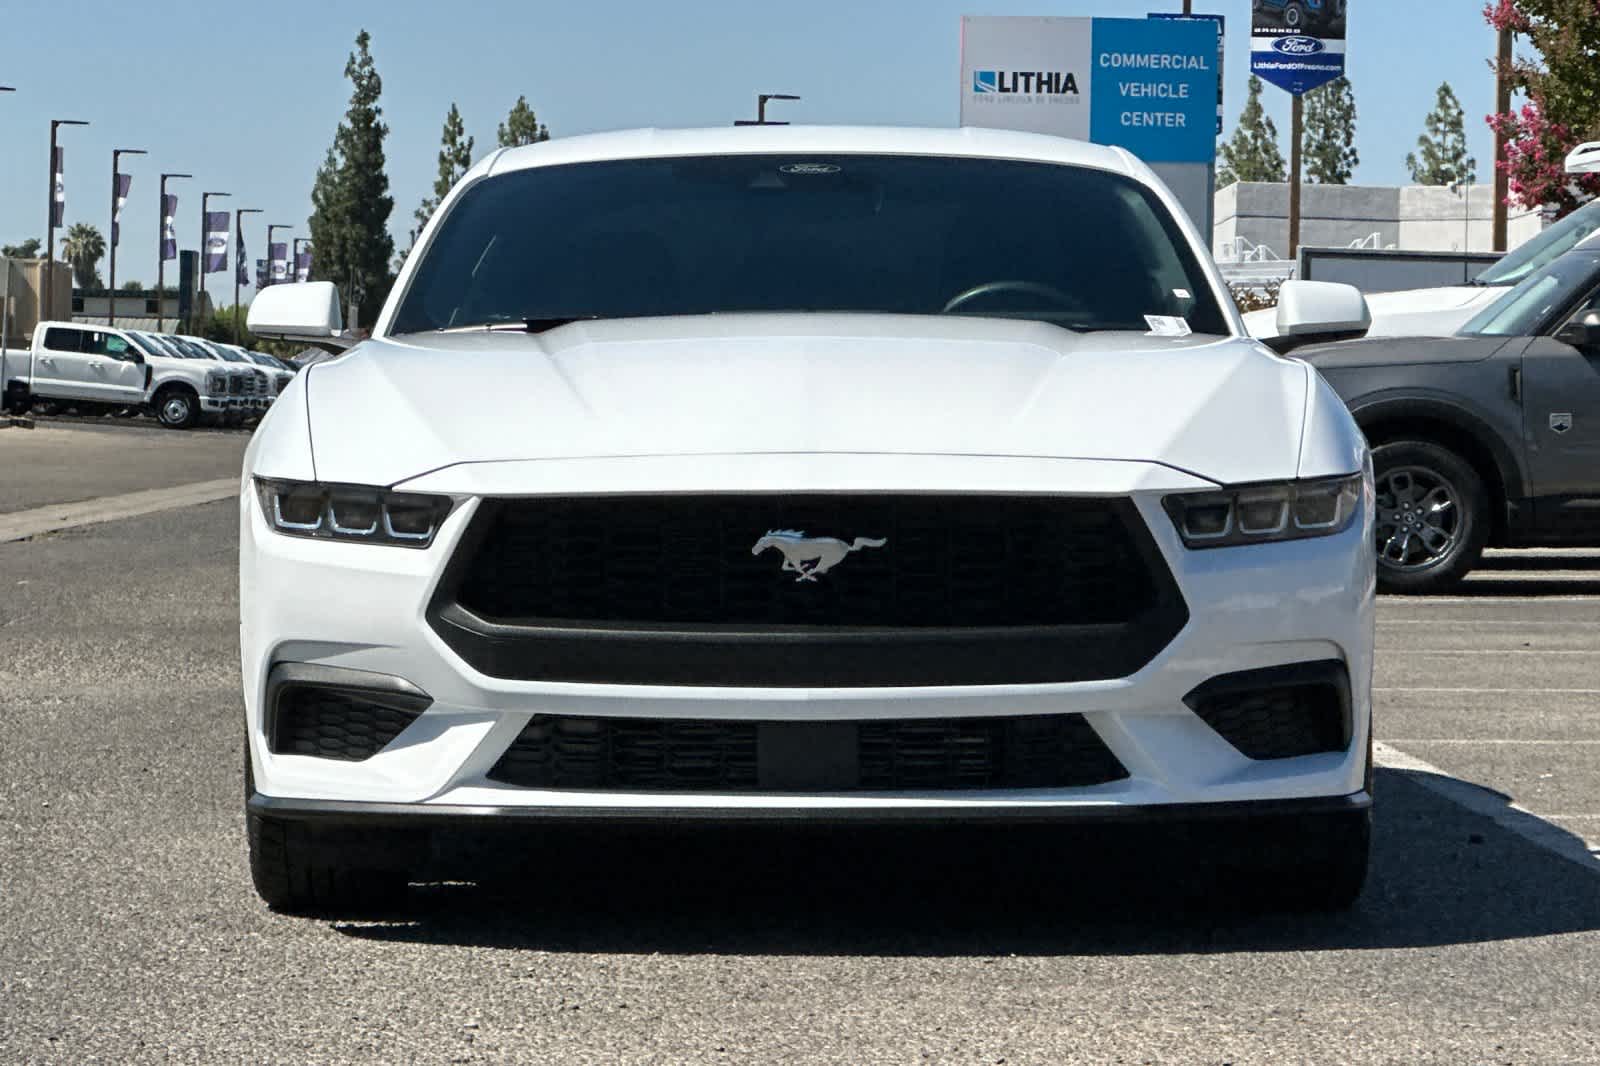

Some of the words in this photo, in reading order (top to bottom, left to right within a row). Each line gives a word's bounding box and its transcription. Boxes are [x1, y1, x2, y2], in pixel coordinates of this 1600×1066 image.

[1282, 38, 1316, 52] Ford
[1100, 53, 1209, 70] COMMERCIAL
[998, 71, 1079, 94] LITHIA
[1118, 82, 1189, 98] VEHICLE
[1120, 111, 1186, 128] CENTER
